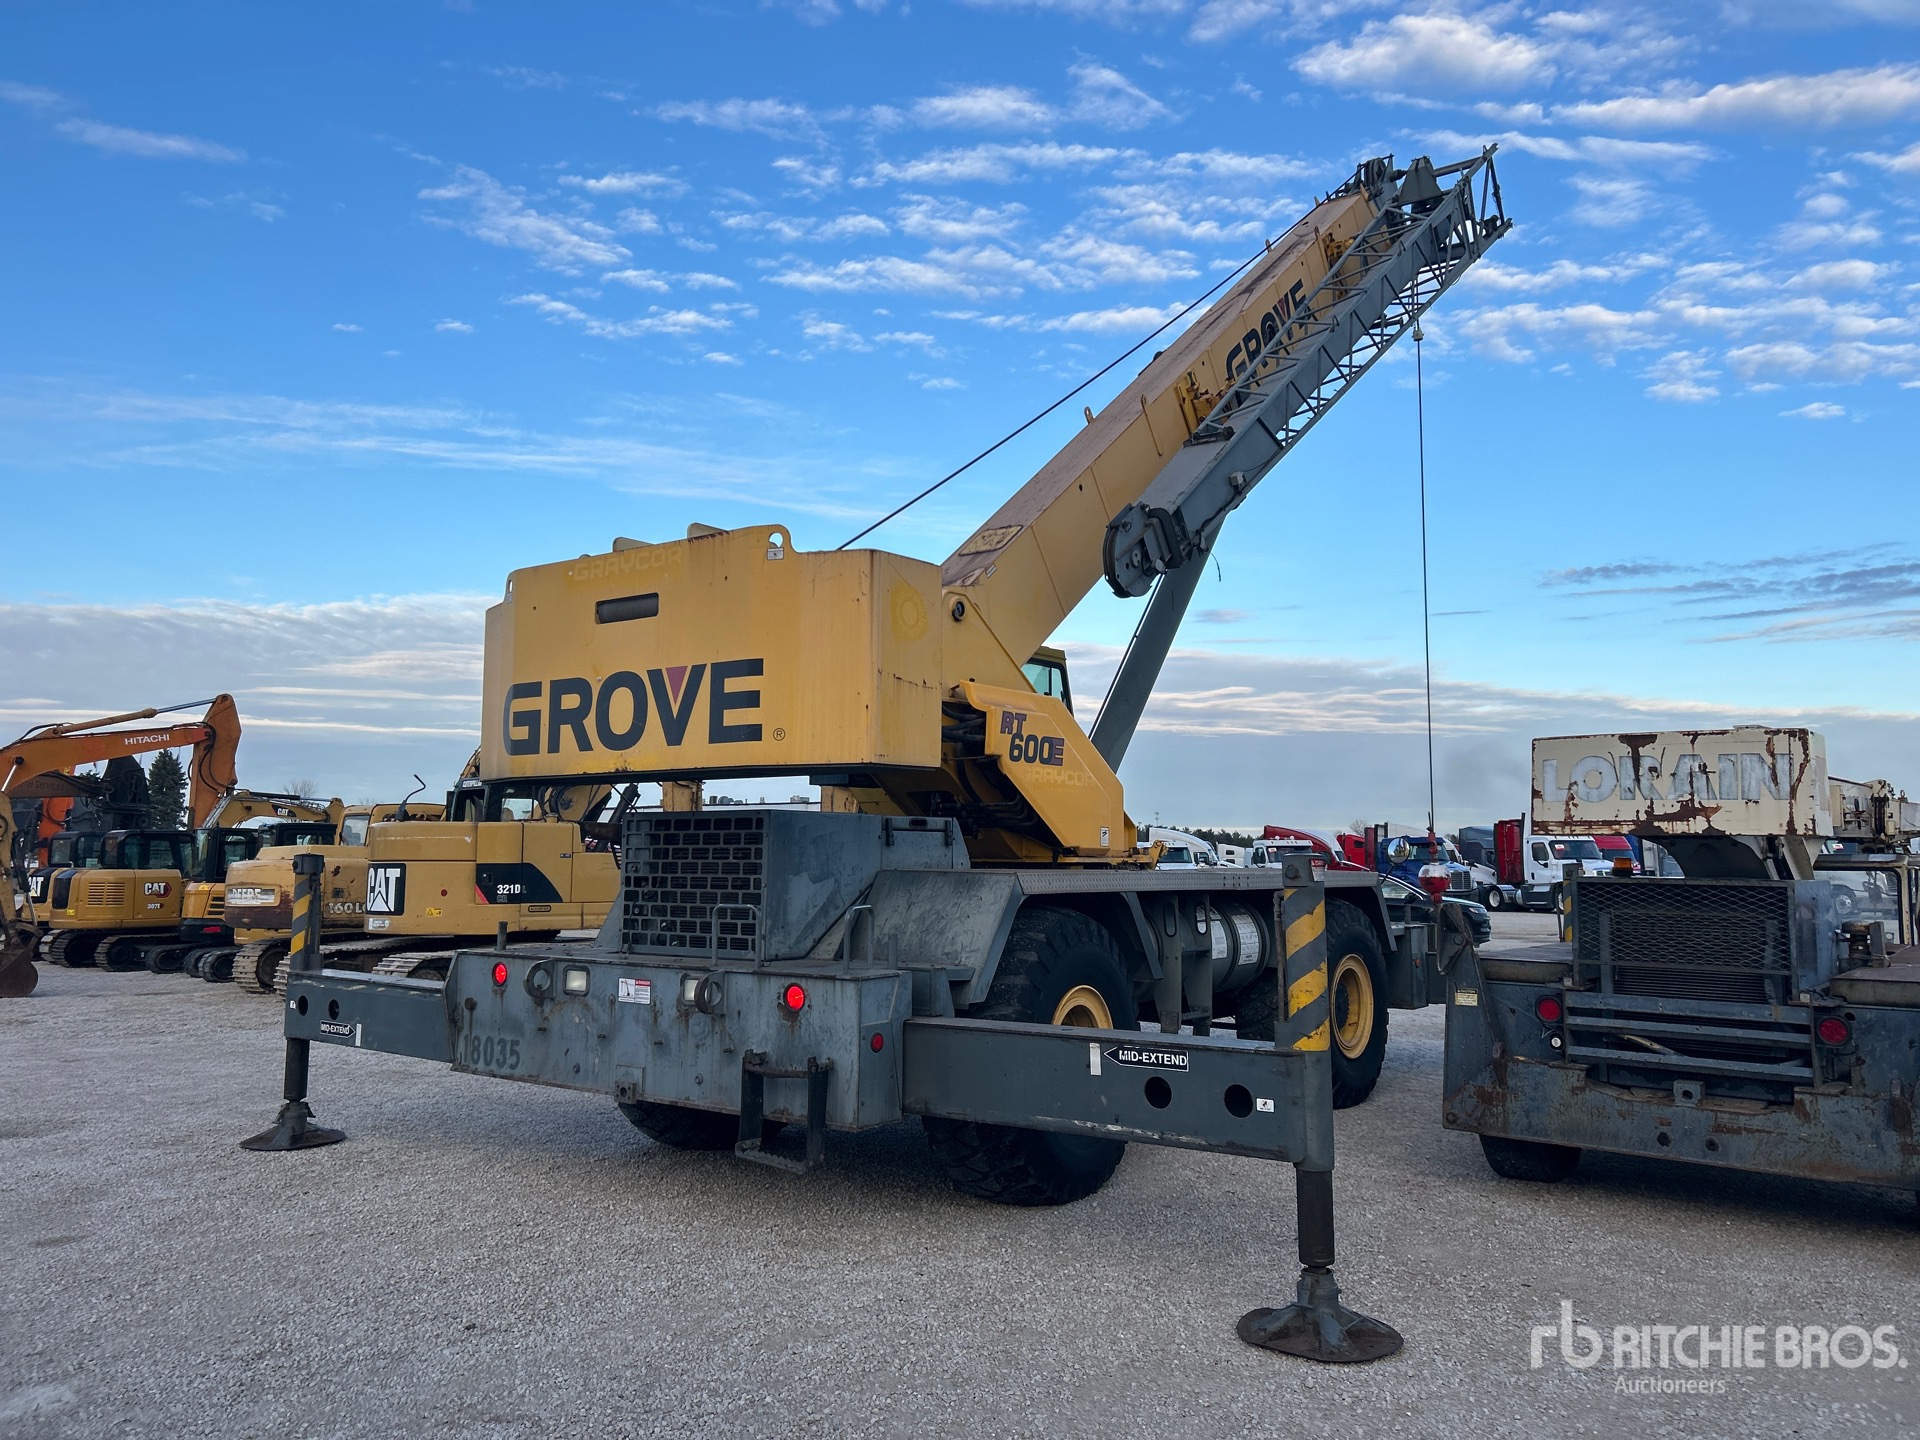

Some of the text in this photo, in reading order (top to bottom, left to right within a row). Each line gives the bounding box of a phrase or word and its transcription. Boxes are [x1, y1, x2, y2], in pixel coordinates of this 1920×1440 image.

[1226, 278, 1319, 388] GROVE
[503, 658, 764, 755] GROVE
[1000, 711, 1027, 736] RT
[124, 733, 170, 745] HITACHI
[1009, 732, 1065, 766] 600E
[1542, 752, 1794, 801] LORAIN
[277, 808, 289, 816] CAT
[144, 882, 166, 895] CAT
[367, 867, 401, 912] CAT
[497, 884, 521, 894] 321D
[1118, 1050, 1187, 1066] MID-EXTEND
